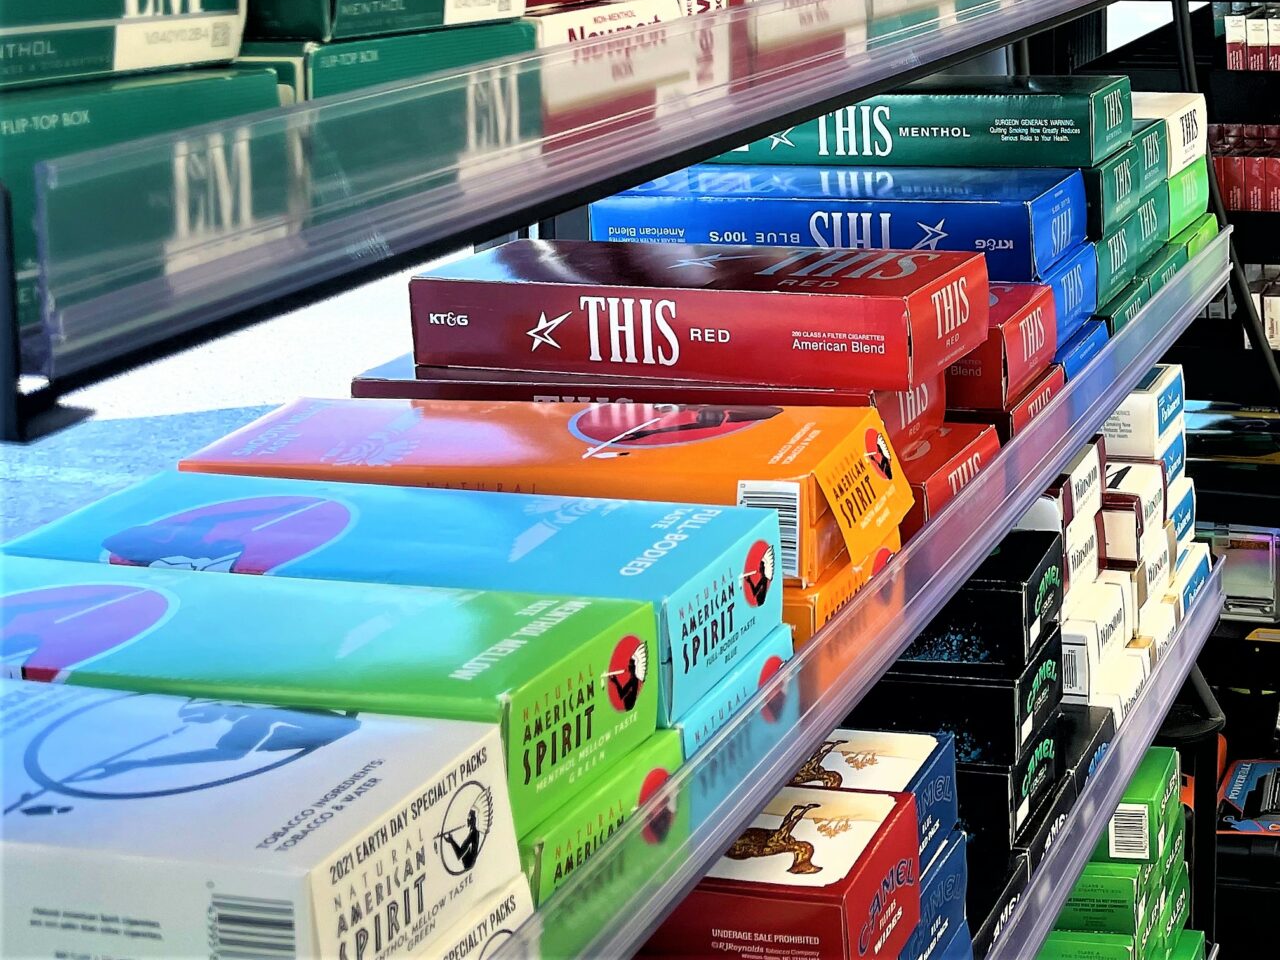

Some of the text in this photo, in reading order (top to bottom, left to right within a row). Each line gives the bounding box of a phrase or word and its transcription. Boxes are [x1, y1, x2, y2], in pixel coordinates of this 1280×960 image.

[342, 0, 405, 14] MENTHOL
[818, 104, 893, 157] THIS
[899, 127, 970, 138] MENTHOL
[1104, 89, 1123, 132] THIS
[1180, 108, 1198, 147] THIS
[608, 226, 685, 238] American Blend
[709, 231, 800, 244] BLUE 100'S
[975, 239, 1014, 251] KT&G
[777, 278, 840, 288] RED
[931, 276, 970, 339] THIS
[429, 312, 469, 327] KT&G
[580, 296, 681, 366] THIS
[689, 328, 731, 343] RED
[792, 330, 801, 338] 200
[802, 331, 820, 339] CLASS
[848, 333, 885, 341] CIGARETTES
[1019, 306, 1045, 362] THIS
[792, 338, 885, 354] American Blend
[950, 366, 982, 377] Blend
[832, 460, 866, 502] AMERICAN
[839, 476, 877, 529] SPIRIT
[1074, 465, 1098, 499] Winston
[619, 509, 723, 576] FULL-BODIED
[1071, 535, 1094, 573] Winston
[678, 567, 734, 620] NATURAL
[681, 581, 735, 641] AMERICAN
[1034, 565, 1061, 617] CAMEL
[682, 602, 735, 675] SPIRIT
[706, 616, 757, 668] FULL-BODIED TASTE
[724, 646, 738, 665] BLUE
[523, 663, 594, 721] NATURAL
[1026, 658, 1058, 714] CAMEL
[523, 680, 595, 746] AMERICAN
[523, 704, 596, 785] SPIRIT
[536, 712, 639, 794] MENTHOL MELLOW TASTE
[569, 751, 606, 784] GREEN
[275, 810, 334, 853] TOBACCO
[342, 777, 383, 806] WATER
[330, 746, 488, 886] 2021 EARTH DAY SPECIALTY PACKS
[1160, 769, 1178, 815] SALEM
[555, 799, 624, 859] NATURAL
[336, 846, 427, 938] AMERICAN
[859, 858, 915, 957] CAMEL
[1165, 887, 1186, 936] SALEM
[407, 919, 436, 952] GREEN
[711, 928, 820, 946] UNDERAGE SALE PROHIBITED
[765, 947, 790, 956] Tobacco
[791, 948, 820, 958] Company
[874, 906, 904, 955] WIDES
